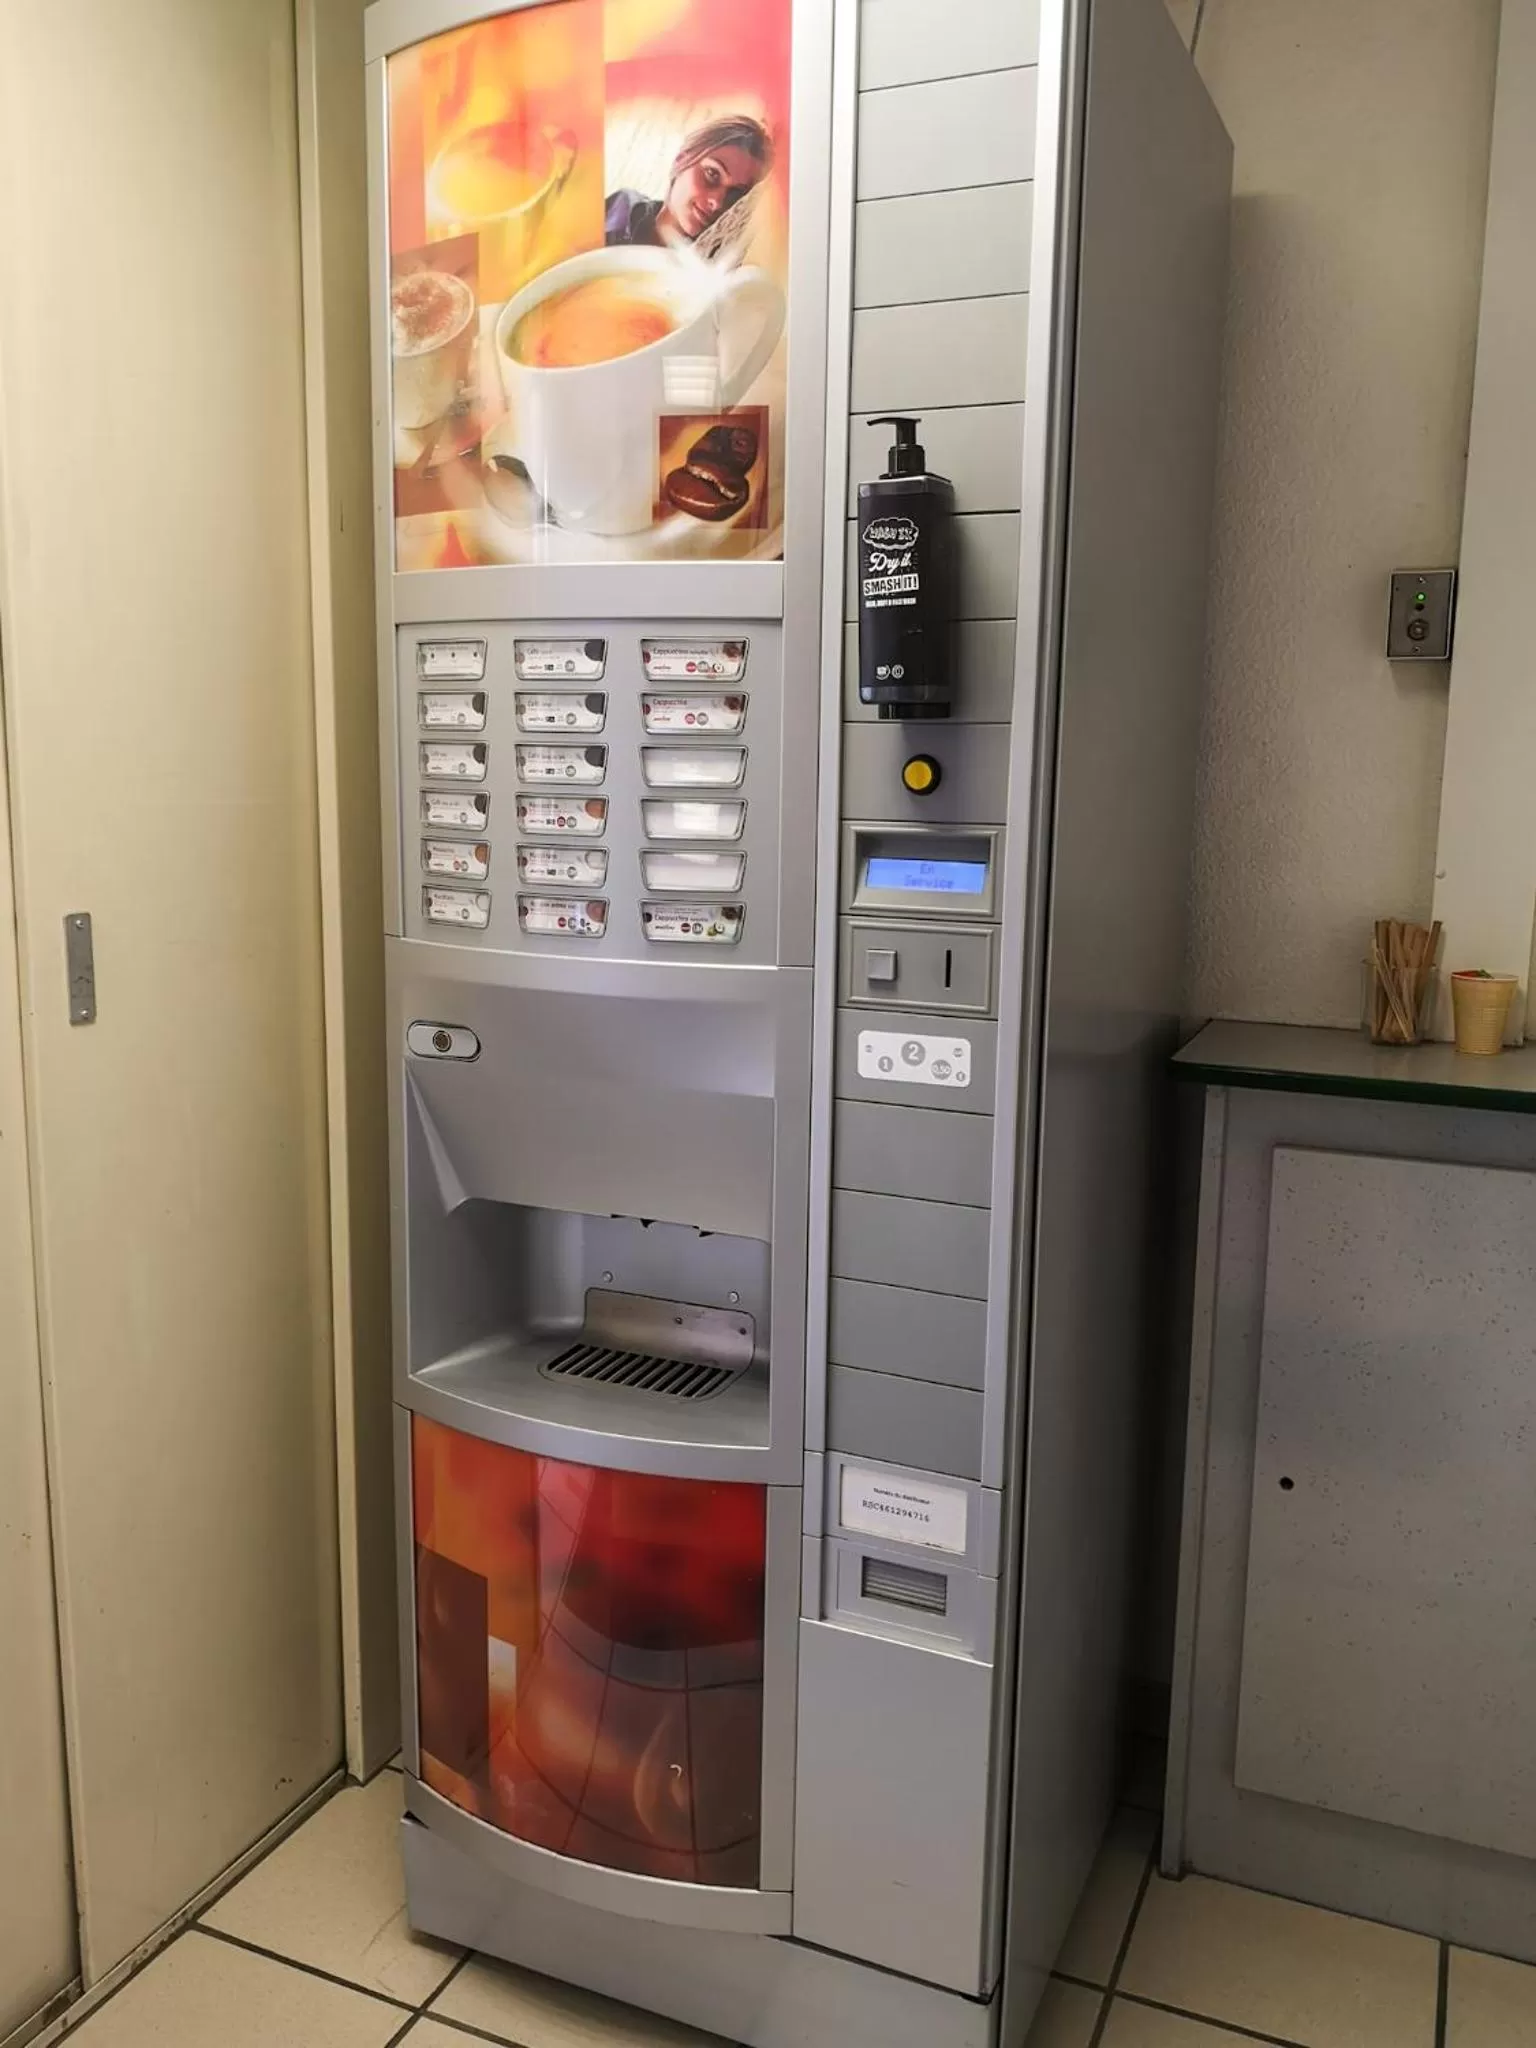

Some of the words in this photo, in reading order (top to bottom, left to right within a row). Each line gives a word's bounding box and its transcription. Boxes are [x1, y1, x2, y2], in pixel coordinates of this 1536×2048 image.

[868, 551, 900, 575] Dry
[864, 578, 901, 594] SMASH
[903, 575, 918, 590] IT!
[903, 874, 955, 890] Service
[908, 1043, 920, 1061] 2
